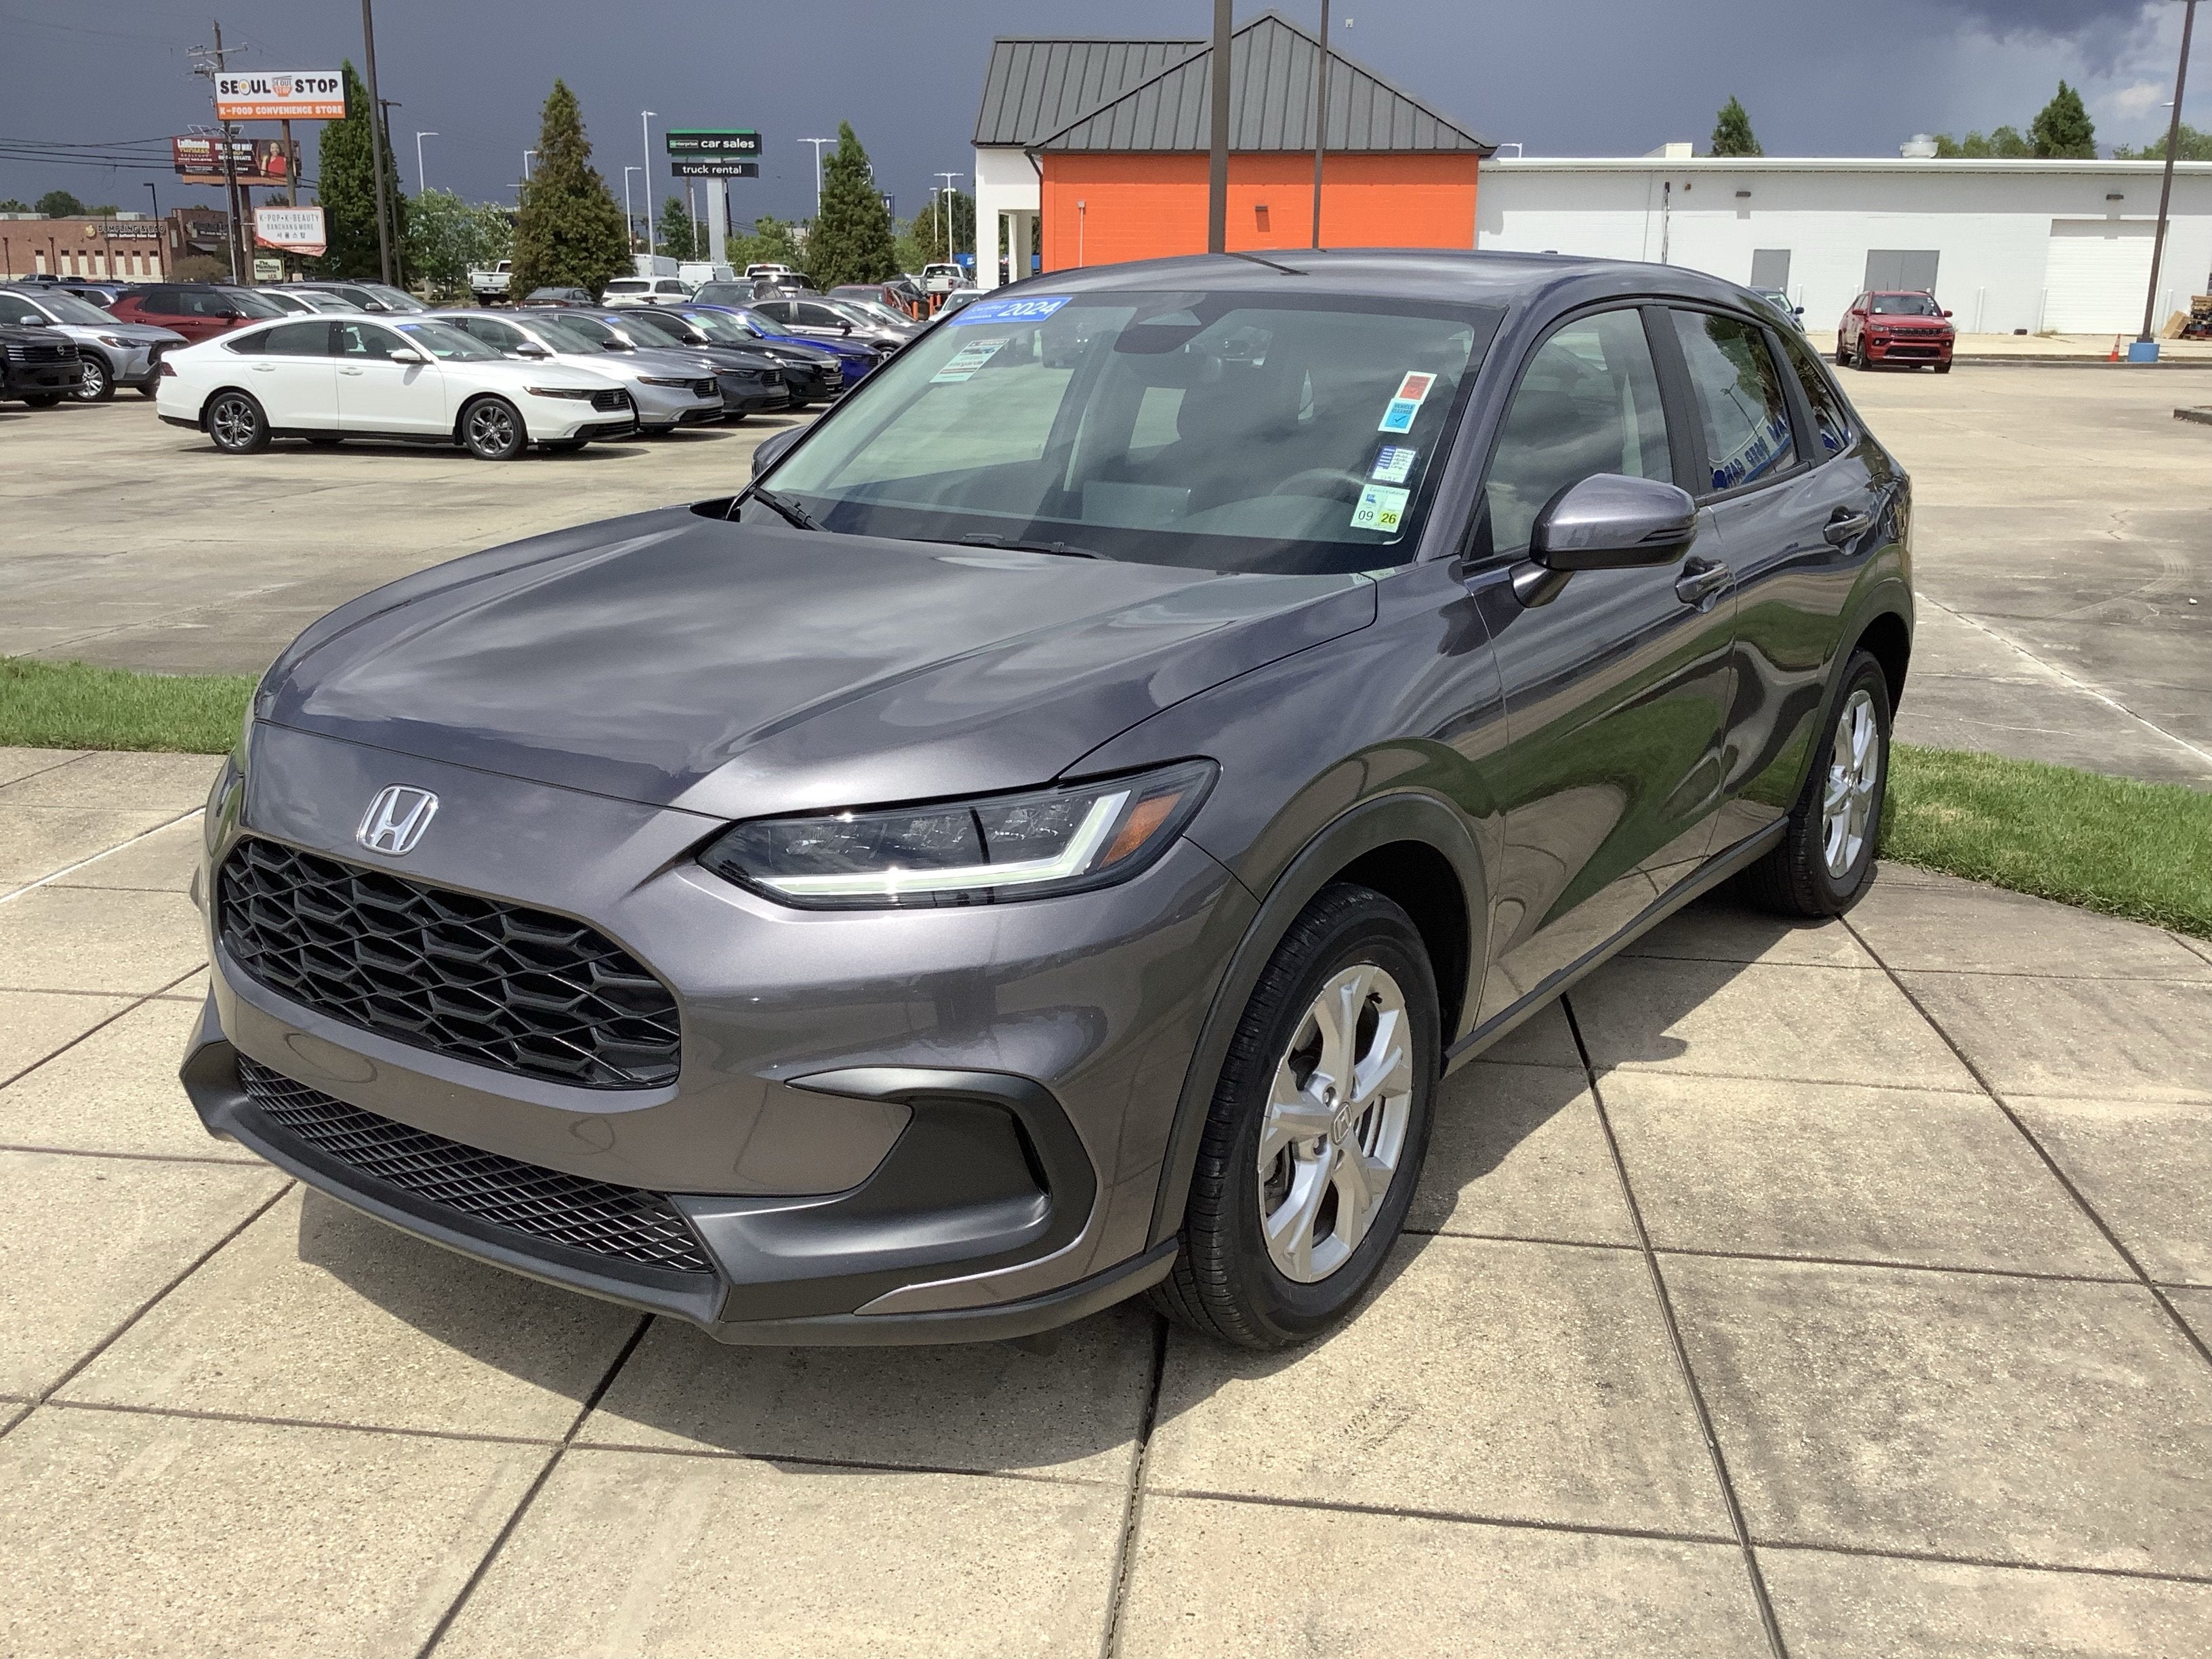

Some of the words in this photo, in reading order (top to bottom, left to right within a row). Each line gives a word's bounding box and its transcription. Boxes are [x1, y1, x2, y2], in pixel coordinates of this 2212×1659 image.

[220, 79, 271, 96] SEOUL
[295, 79, 338, 94] STOP
[220, 106, 253, 115] K-FOOD
[255, 106, 312, 115] CONVENIENCE
[315, 105, 343, 114] STORE
[701, 140, 720, 148] car
[723, 138, 755, 148] sales
[682, 165, 709, 174] truck
[712, 165, 741, 174] rental
[997, 300, 1062, 317] 2024
[1358, 510, 1374, 521] 09
[1380, 513, 1397, 524] 26
